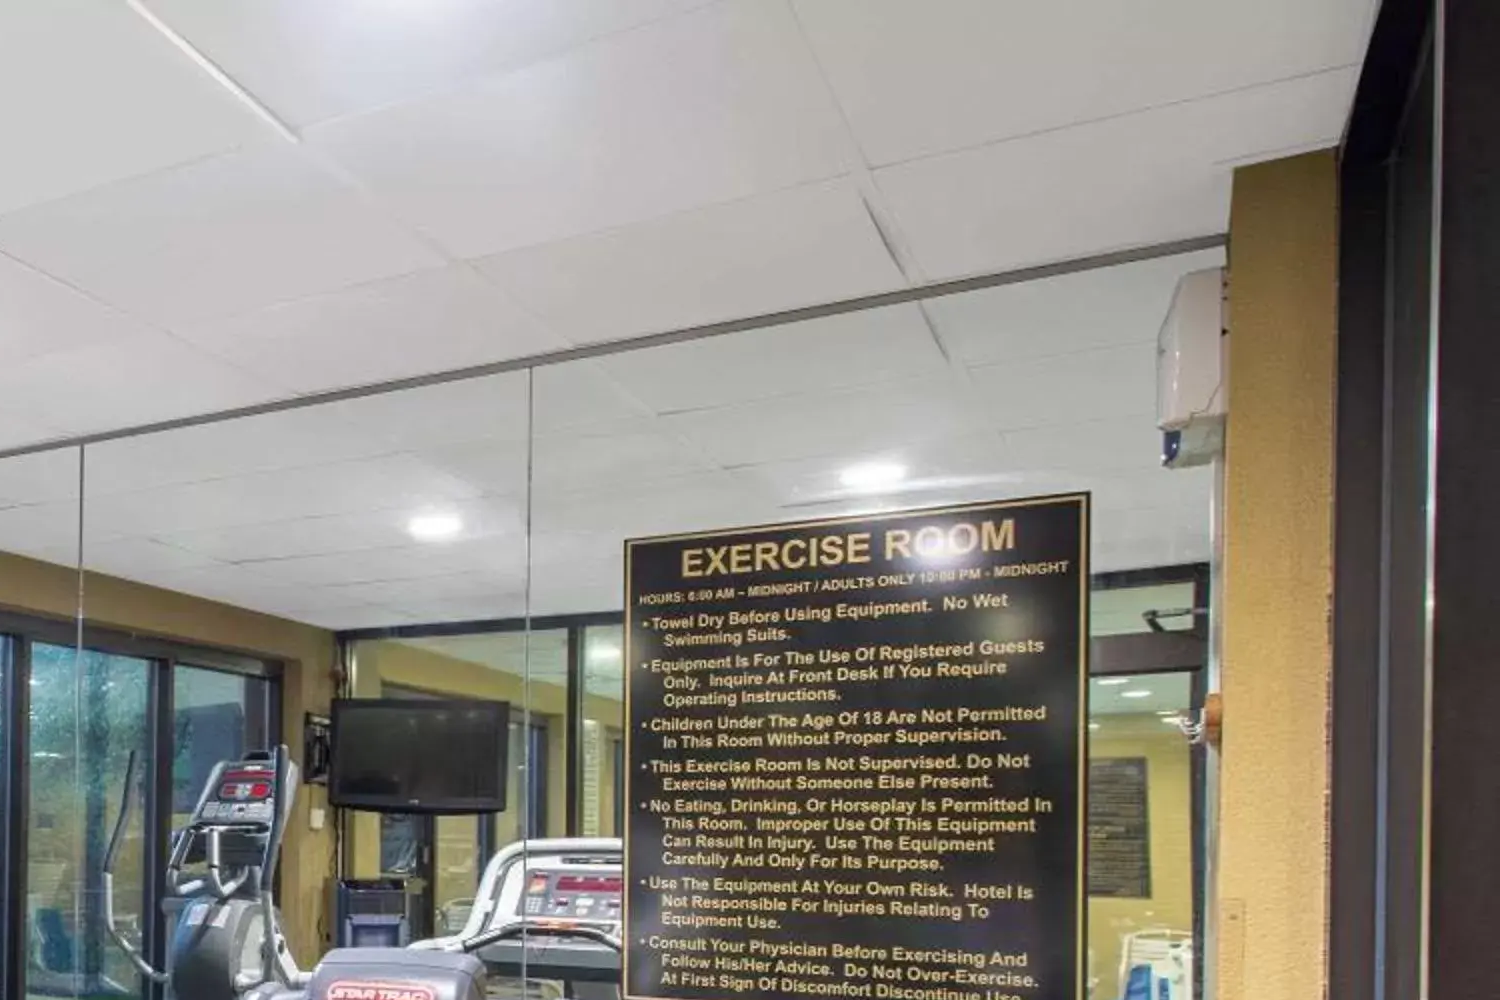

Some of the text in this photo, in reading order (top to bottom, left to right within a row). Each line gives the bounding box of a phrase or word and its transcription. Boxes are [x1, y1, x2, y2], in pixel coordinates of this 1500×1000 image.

[681, 517, 1014, 579] EXERCISE ROOM
[651, 593, 1009, 630] Towel Dry Before Using Equipment. No Wet
[663, 627, 791, 647] Swimming Suits.
[651, 639, 1044, 674] Equipment Is For The Use Of Registered Guests
[663, 659, 1007, 690] Only. Inquire At Front Desk If You Require
[662, 687, 841, 709] Operating Instructions.
[650, 705, 1046, 731] Children Under The Age Of 18 Are Not Permitted
[663, 726, 1007, 749] In This Room Without Proper Supervision.
[649, 753, 1030, 773] This Exercise Room Is Not Supervised. Do Not
[662, 773, 993, 791] Exercise Without Someone Else Present.
[649, 796, 1052, 815] No Eating, Drinking, Or Horseplay Is Permitted In
[661, 815, 1036, 834] This Room. Improper Use Of This Equipment
[661, 832, 994, 854] Can Result In Injury. Use The Equipment
[661, 851, 944, 872] Carefully And Only For Its Purpose.
[649, 875, 1033, 899] Use The Equipment At Your Own Risk. Hotel Is
[661, 893, 989, 920] Not Responsible For Injuries Relating To
[661, 910, 781, 928] Equipment Use.
[648, 935, 1027, 968] Consult Your Physician Before Exercising And
[661, 952, 1038, 987] Follow His/Her Advice. Do Not Over-Exercise.
[332, 988, 376, 1000] STAR
[659, 971, 677, 984] At
[681, 971, 715, 986] First
[719, 973, 754, 991] Sign
[757, 976, 778, 991] Of
[780, 977, 871, 997] Discomfort
